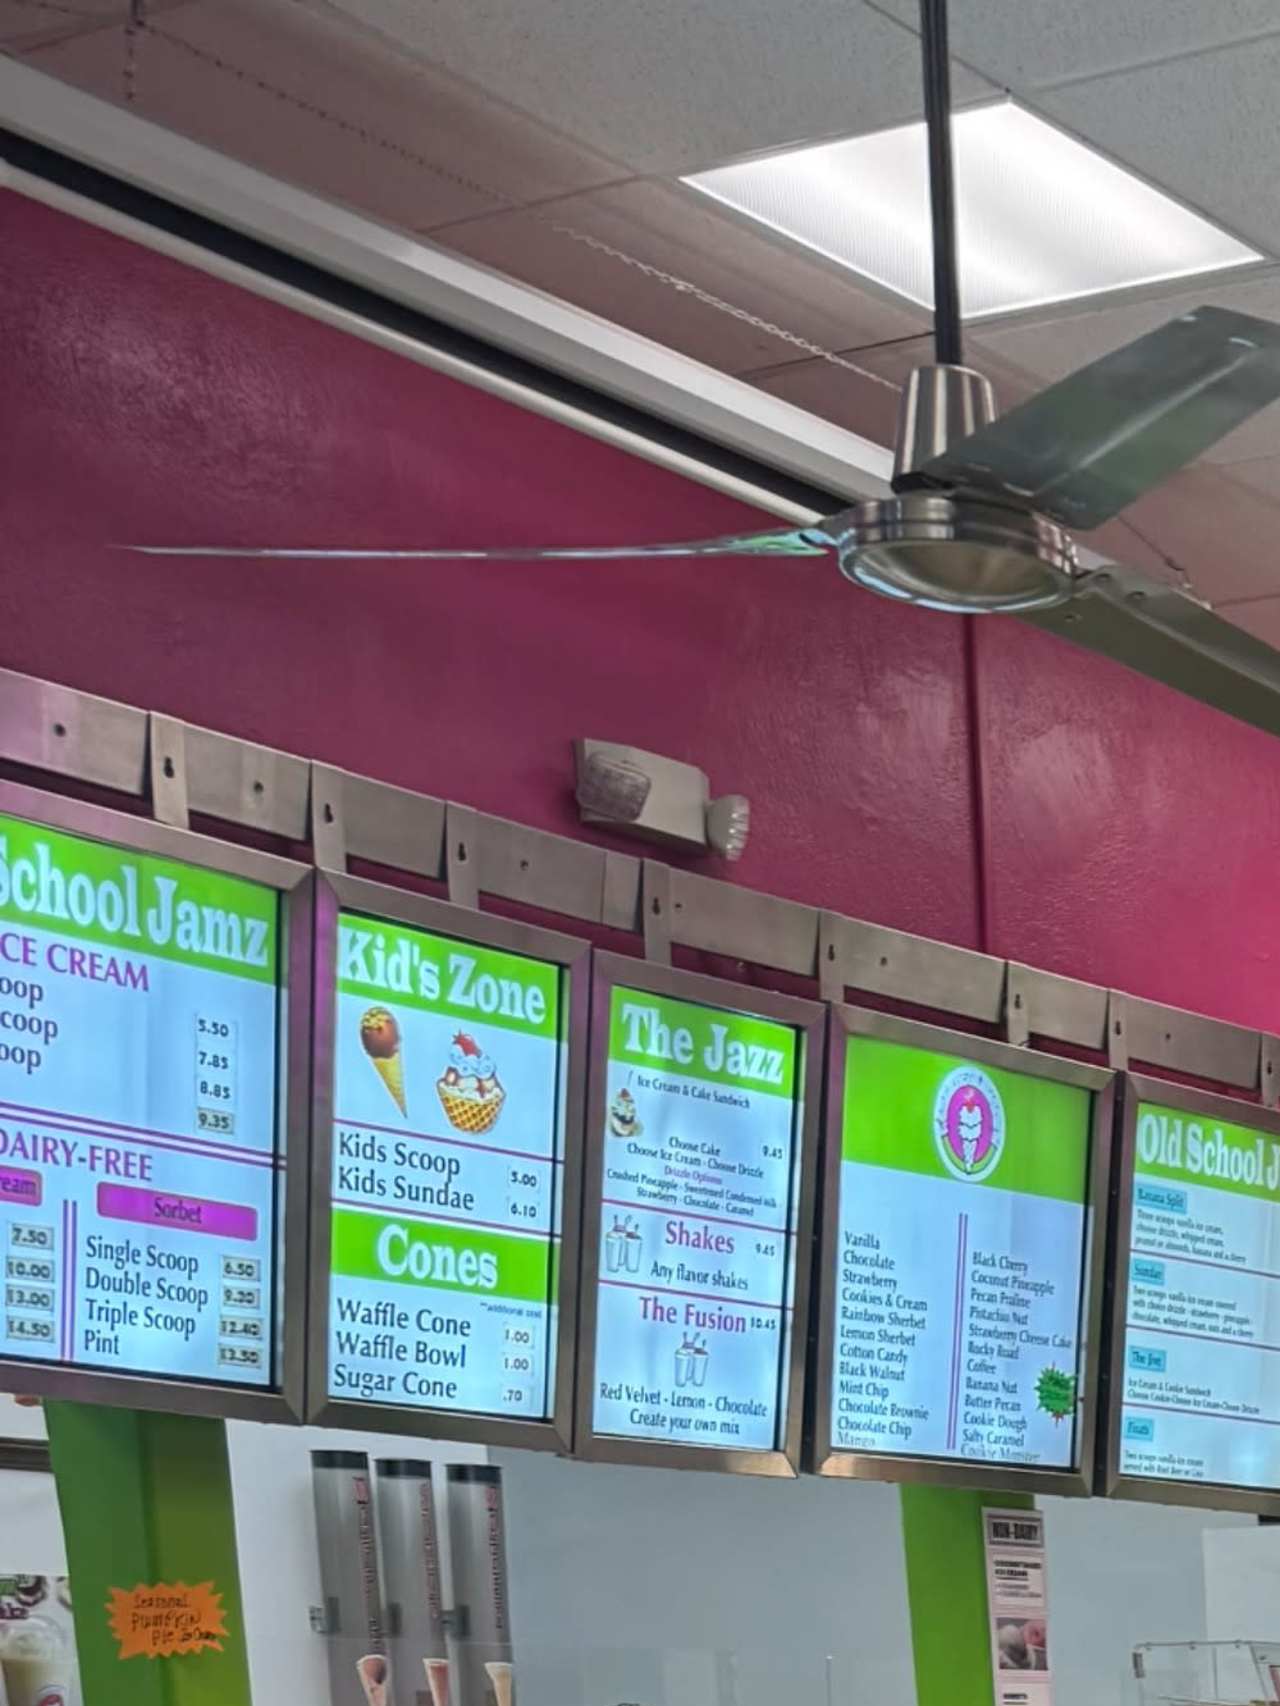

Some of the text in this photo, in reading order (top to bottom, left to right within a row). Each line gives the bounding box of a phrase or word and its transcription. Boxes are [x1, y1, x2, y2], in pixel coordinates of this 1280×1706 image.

[148, 876, 268, 967] Jamz
[47, 944, 150, 993] CREAM
[336, 925, 546, 1025] Kid's Zone
[198, 1019, 229, 1037] 5.50
[621, 1002, 785, 1086] The Jazz
[198, 1051, 229, 1070] 7.85
[200, 1080, 231, 1100] 8.85
[637, 1074, 652, 1090] Ice
[652, 1076, 680, 1096] Cream
[691, 1084, 711, 1101] Cake
[713, 1089, 751, 1109] Sandwich
[198, 1109, 230, 1129] 9.35
[338, 1131, 387, 1164] Kids
[393, 1142, 460, 1184] Scoop
[700, 1142, 721, 1158] Cake
[1138, 1113, 1183, 1168] Old
[1186, 1122, 1265, 1186] School
[337, 1165, 387, 1196] Kids
[393, 1175, 475, 1212] Sundae
[154, 1198, 203, 1225] Sorbet
[665, 1219, 735, 1255] Shakes
[844, 1230, 881, 1251] Vanilla
[86, 1235, 141, 1271] Single
[146, 1244, 199, 1281] Scoop
[377, 1224, 498, 1289] Cones
[843, 1249, 896, 1271] Chocolate
[972, 1251, 997, 1268] Black
[650, 1260, 749, 1291] Any flavor shakes
[842, 1269, 898, 1292] Strawberry
[1011, 1276, 1055, 1298] Pineapple
[85, 1267, 209, 1313] Double Scoop
[842, 1287, 884, 1307] Cookies
[895, 1297, 928, 1312] Cream
[85, 1298, 139, 1332] Triple
[143, 1306, 196, 1342] Scoop
[336, 1298, 410, 1330] Waffle
[415, 1309, 471, 1337] Cone
[640, 1295, 678, 1325] The
[684, 1303, 747, 1333] Fusion
[841, 1306, 927, 1330] Rainbow Sherbet
[84, 1329, 120, 1356] Pint
[335, 1330, 408, 1362] Waffle
[415, 1341, 466, 1369] Bowl
[840, 1324, 917, 1348] Lemon Sherbet
[839, 1342, 909, 1368] Cotton Candy
[334, 1363, 396, 1398] Sugar
[402, 1371, 457, 1400] Cone
[839, 1361, 906, 1382] Black Walnut
[600, 1382, 622, 1401] Red
[625, 1385, 661, 1408] Velvet
[671, 1391, 706, 1409] Lemon
[714, 1395, 768, 1418] Chocolate
[839, 1379, 890, 1402] Mint Chip
[838, 1397, 888, 1417] Chocolate
[629, 1408, 741, 1435] Create your own mix
[837, 1415, 912, 1441] Chocolate Chip
